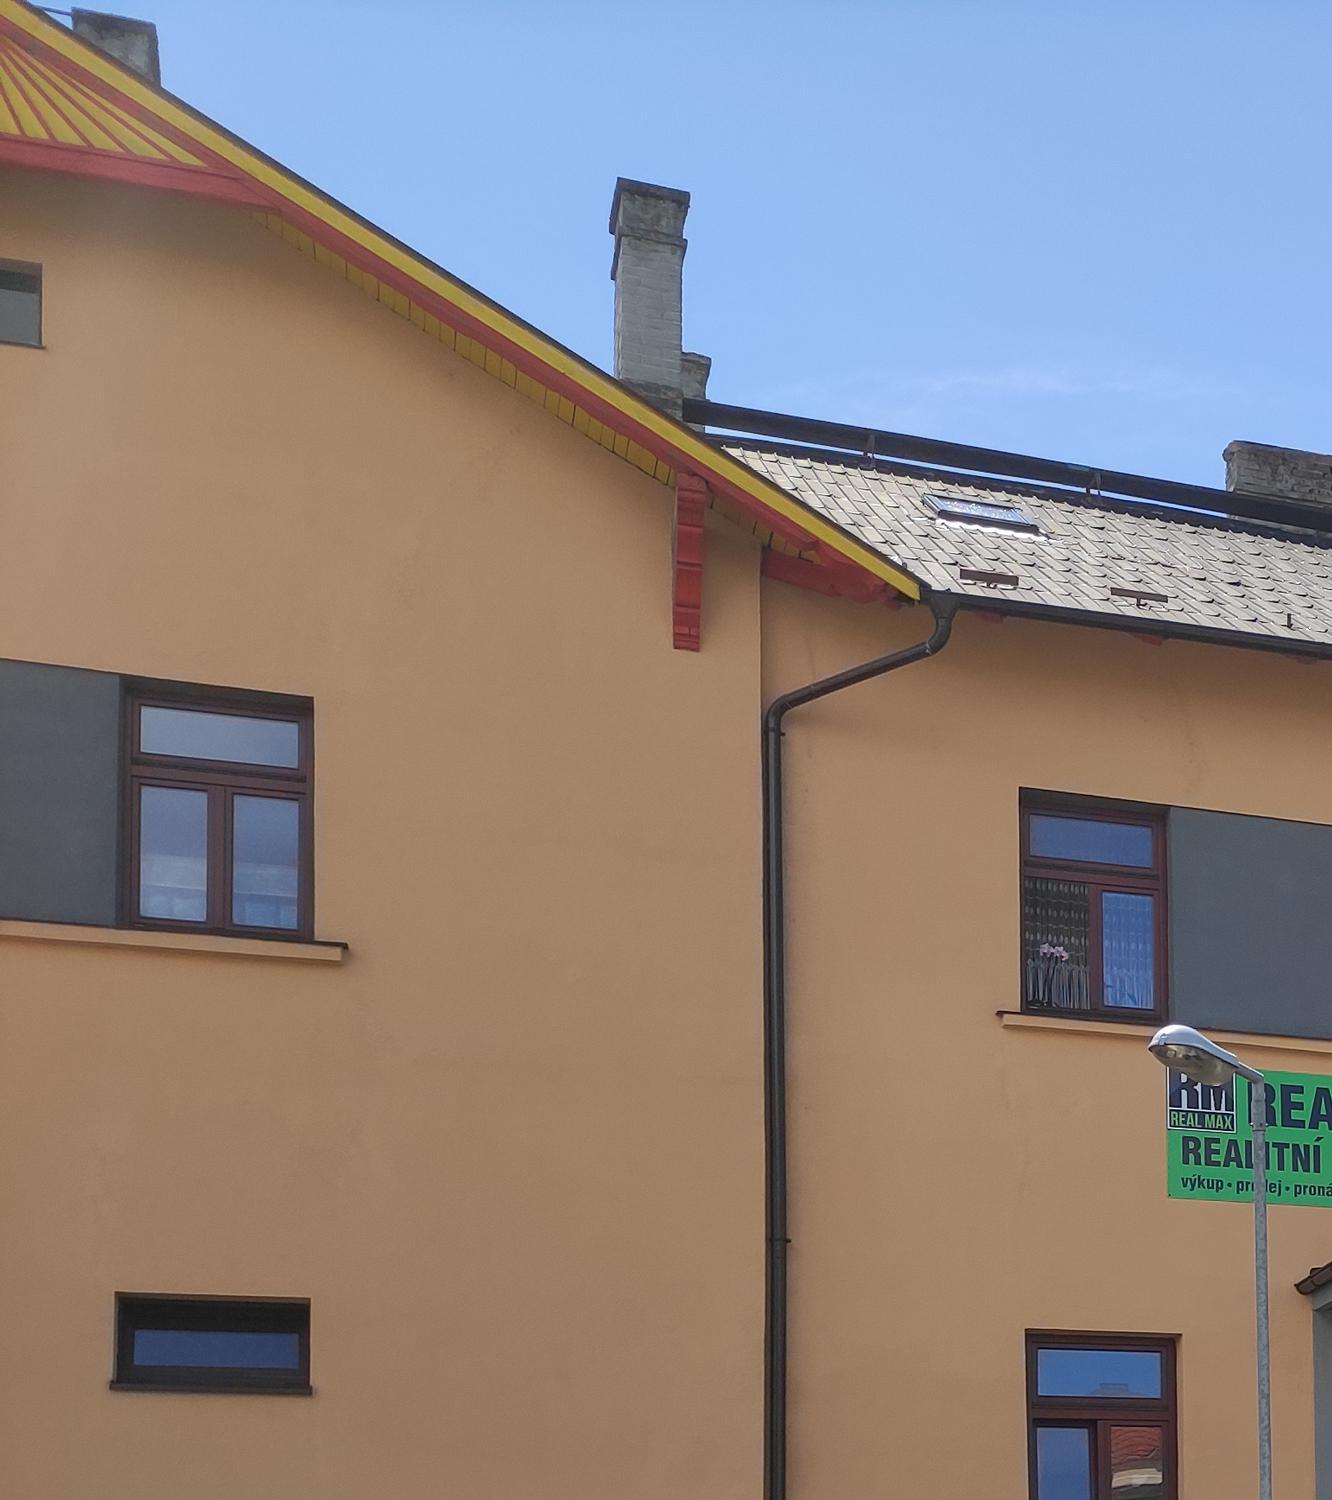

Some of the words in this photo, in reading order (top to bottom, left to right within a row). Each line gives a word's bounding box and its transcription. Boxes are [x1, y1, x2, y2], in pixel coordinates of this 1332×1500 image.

[1170, 1111, 1202, 1128] REAL
[1204, 1114, 1233, 1130] MAX
[1181, 1174, 1224, 1193] výkup
[1236, 1180, 1282, 1197] prej
